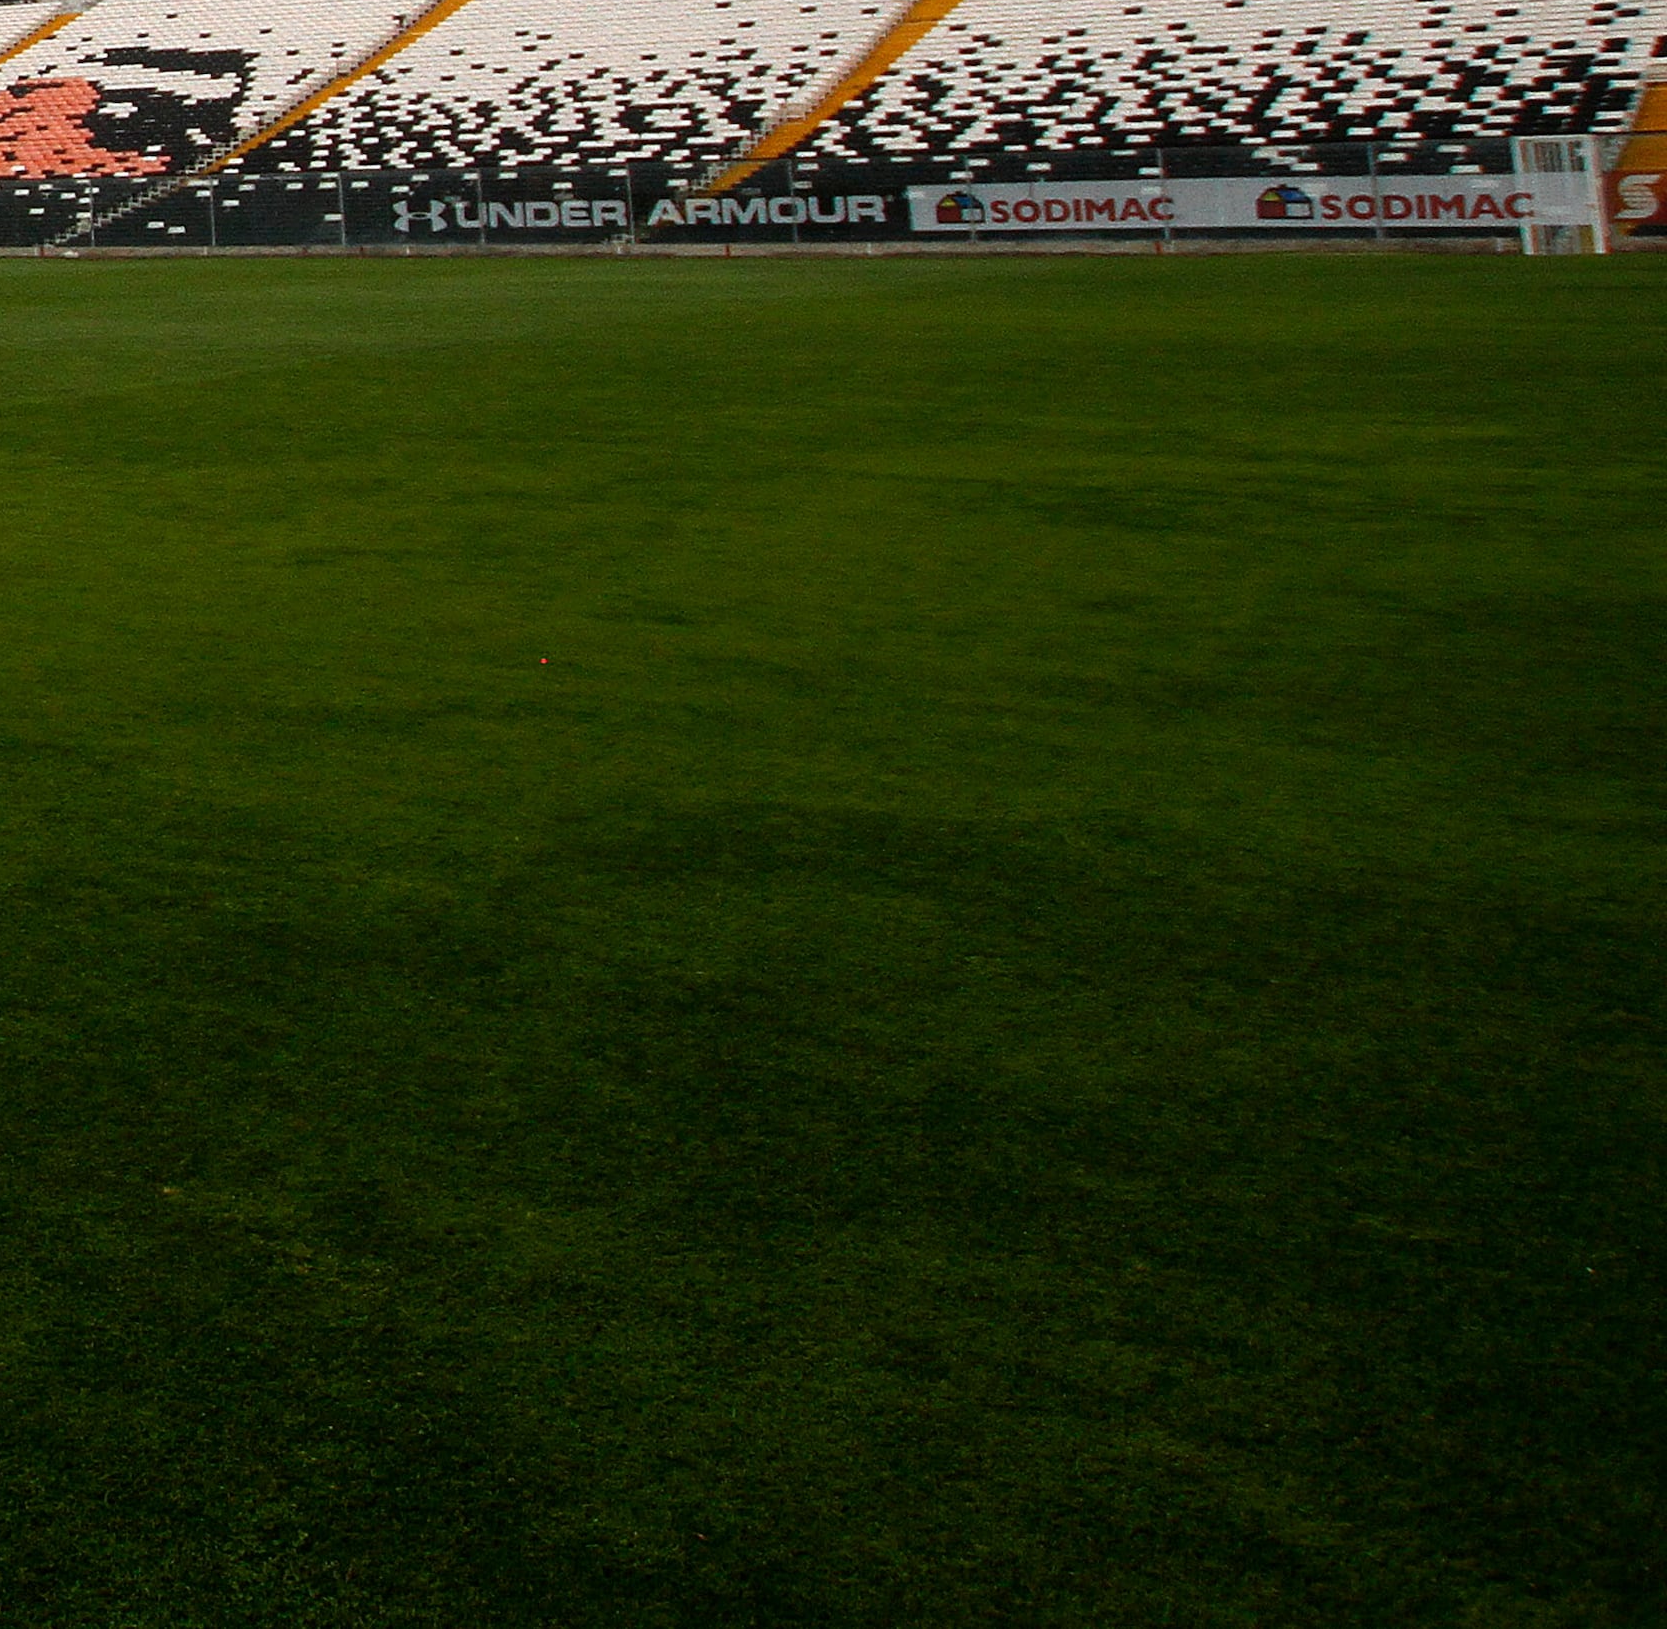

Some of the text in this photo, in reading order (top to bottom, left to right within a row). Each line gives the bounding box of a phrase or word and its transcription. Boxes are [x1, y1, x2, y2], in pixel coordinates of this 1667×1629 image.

[454, 195, 888, 229] UNDER ARMOUR
[990, 192, 1536, 224] SODIMAC SODIMAC
